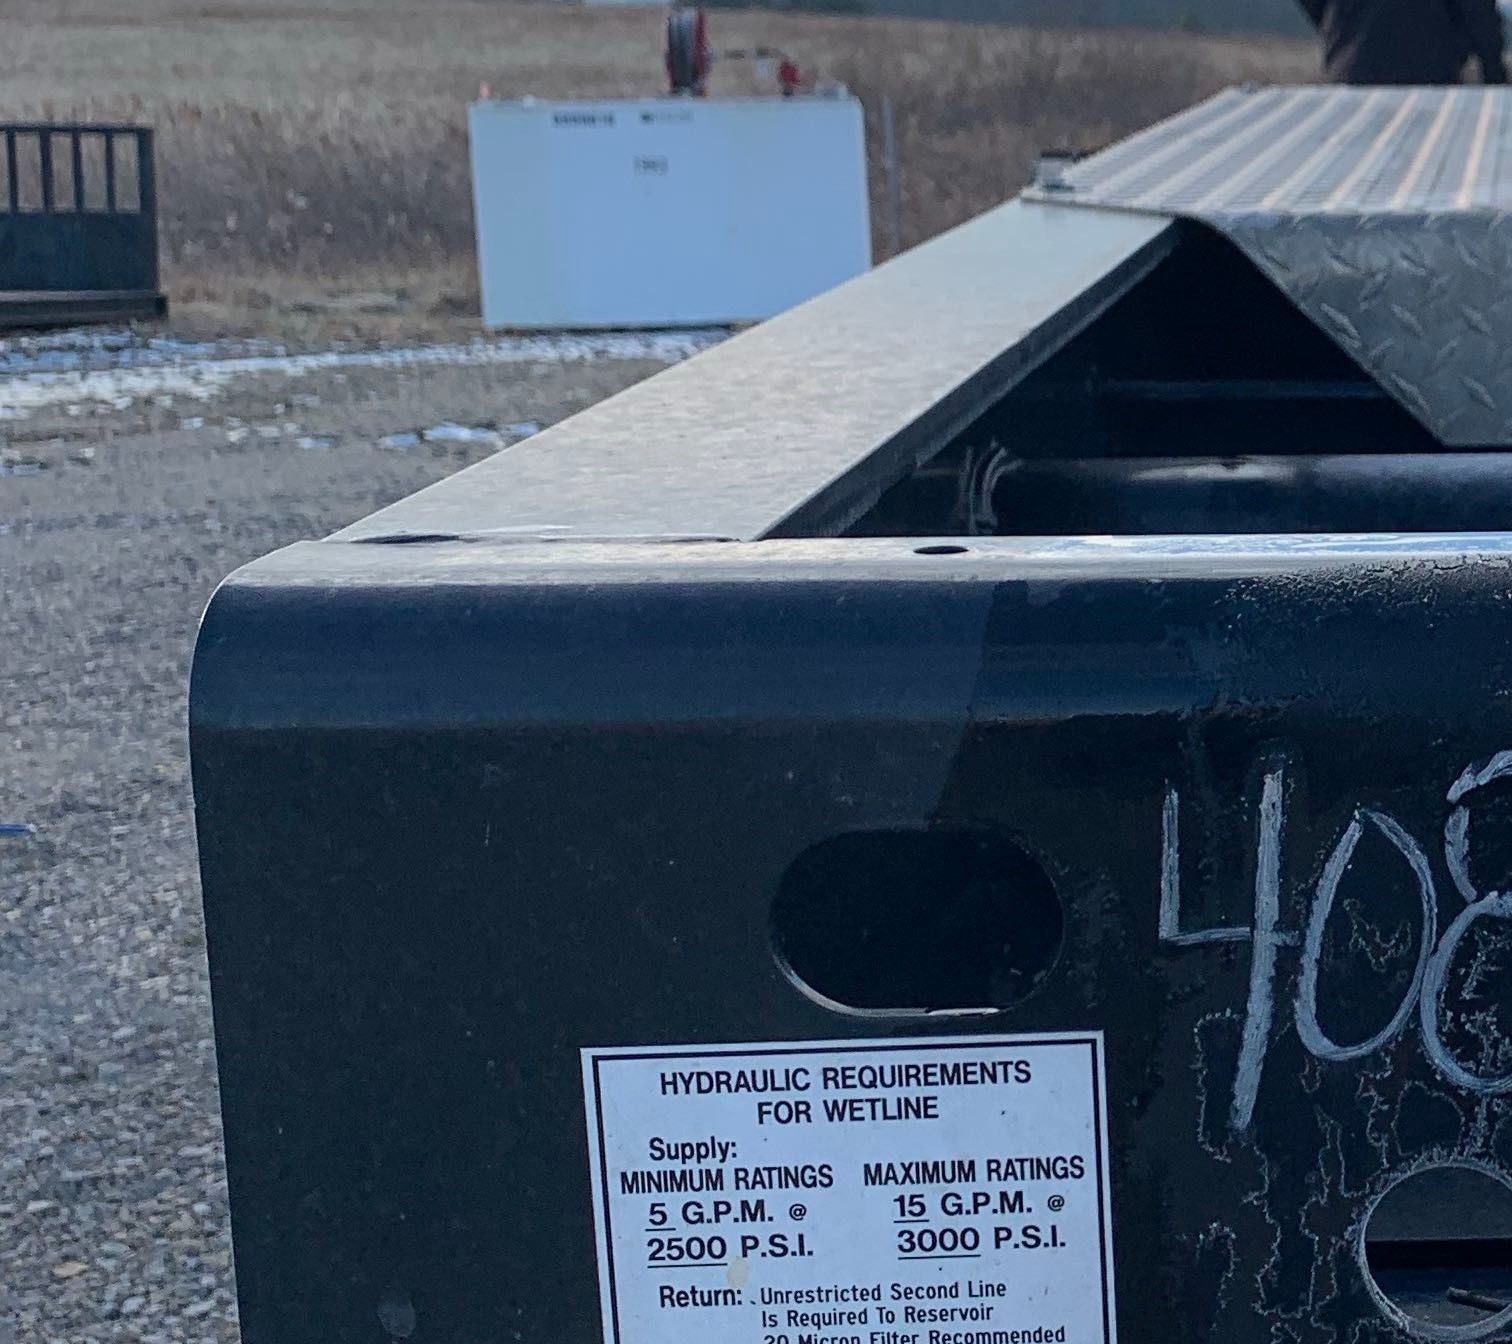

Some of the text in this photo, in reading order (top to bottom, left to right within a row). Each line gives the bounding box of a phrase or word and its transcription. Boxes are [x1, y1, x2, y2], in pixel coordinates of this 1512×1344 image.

[661, 1060, 1031, 1095] HYDRAULIC REQUIREMENTS
[758, 1096, 939, 1124] FOR WETLINE
[650, 1136, 737, 1164] Supply:
[621, 1164, 833, 1194] MINIMUM RATINGS
[864, 1155, 1084, 1186] MAXIMUM RATINGS
[649, 1199, 806, 1225] 5 G.P.M. @
[893, 1191, 1064, 1217] 15 G.P.M. @
[647, 1234, 813, 1261] 2500 P.S.I.
[898, 1225, 1065, 1253] 3000 P.S.I.
[660, 1280, 1006, 1308] Return: Unrestricted Second Line
[762, 1303, 993, 1330] Is Required To Reservoir
